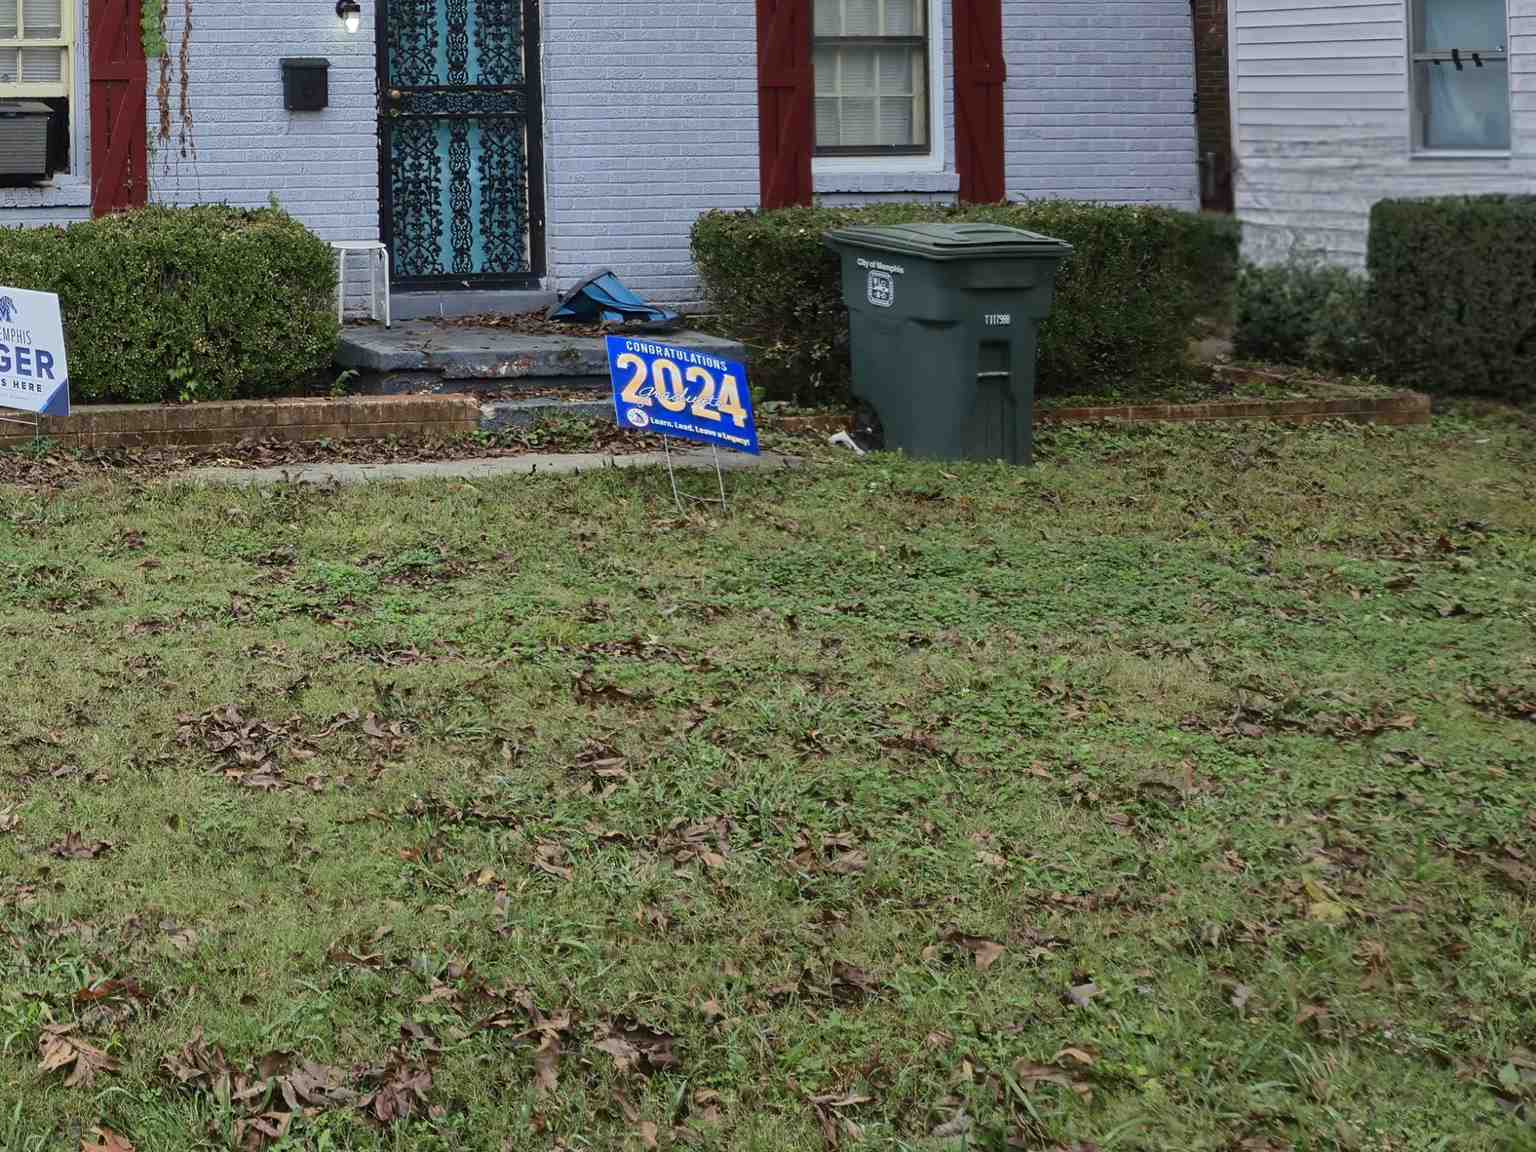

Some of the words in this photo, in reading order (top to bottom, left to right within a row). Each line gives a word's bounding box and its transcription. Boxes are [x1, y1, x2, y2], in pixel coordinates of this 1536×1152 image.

[626, 341, 727, 372] CONGRATULATIONS
[13, 381, 42, 393] HERE
[617, 352, 747, 428] 2024
